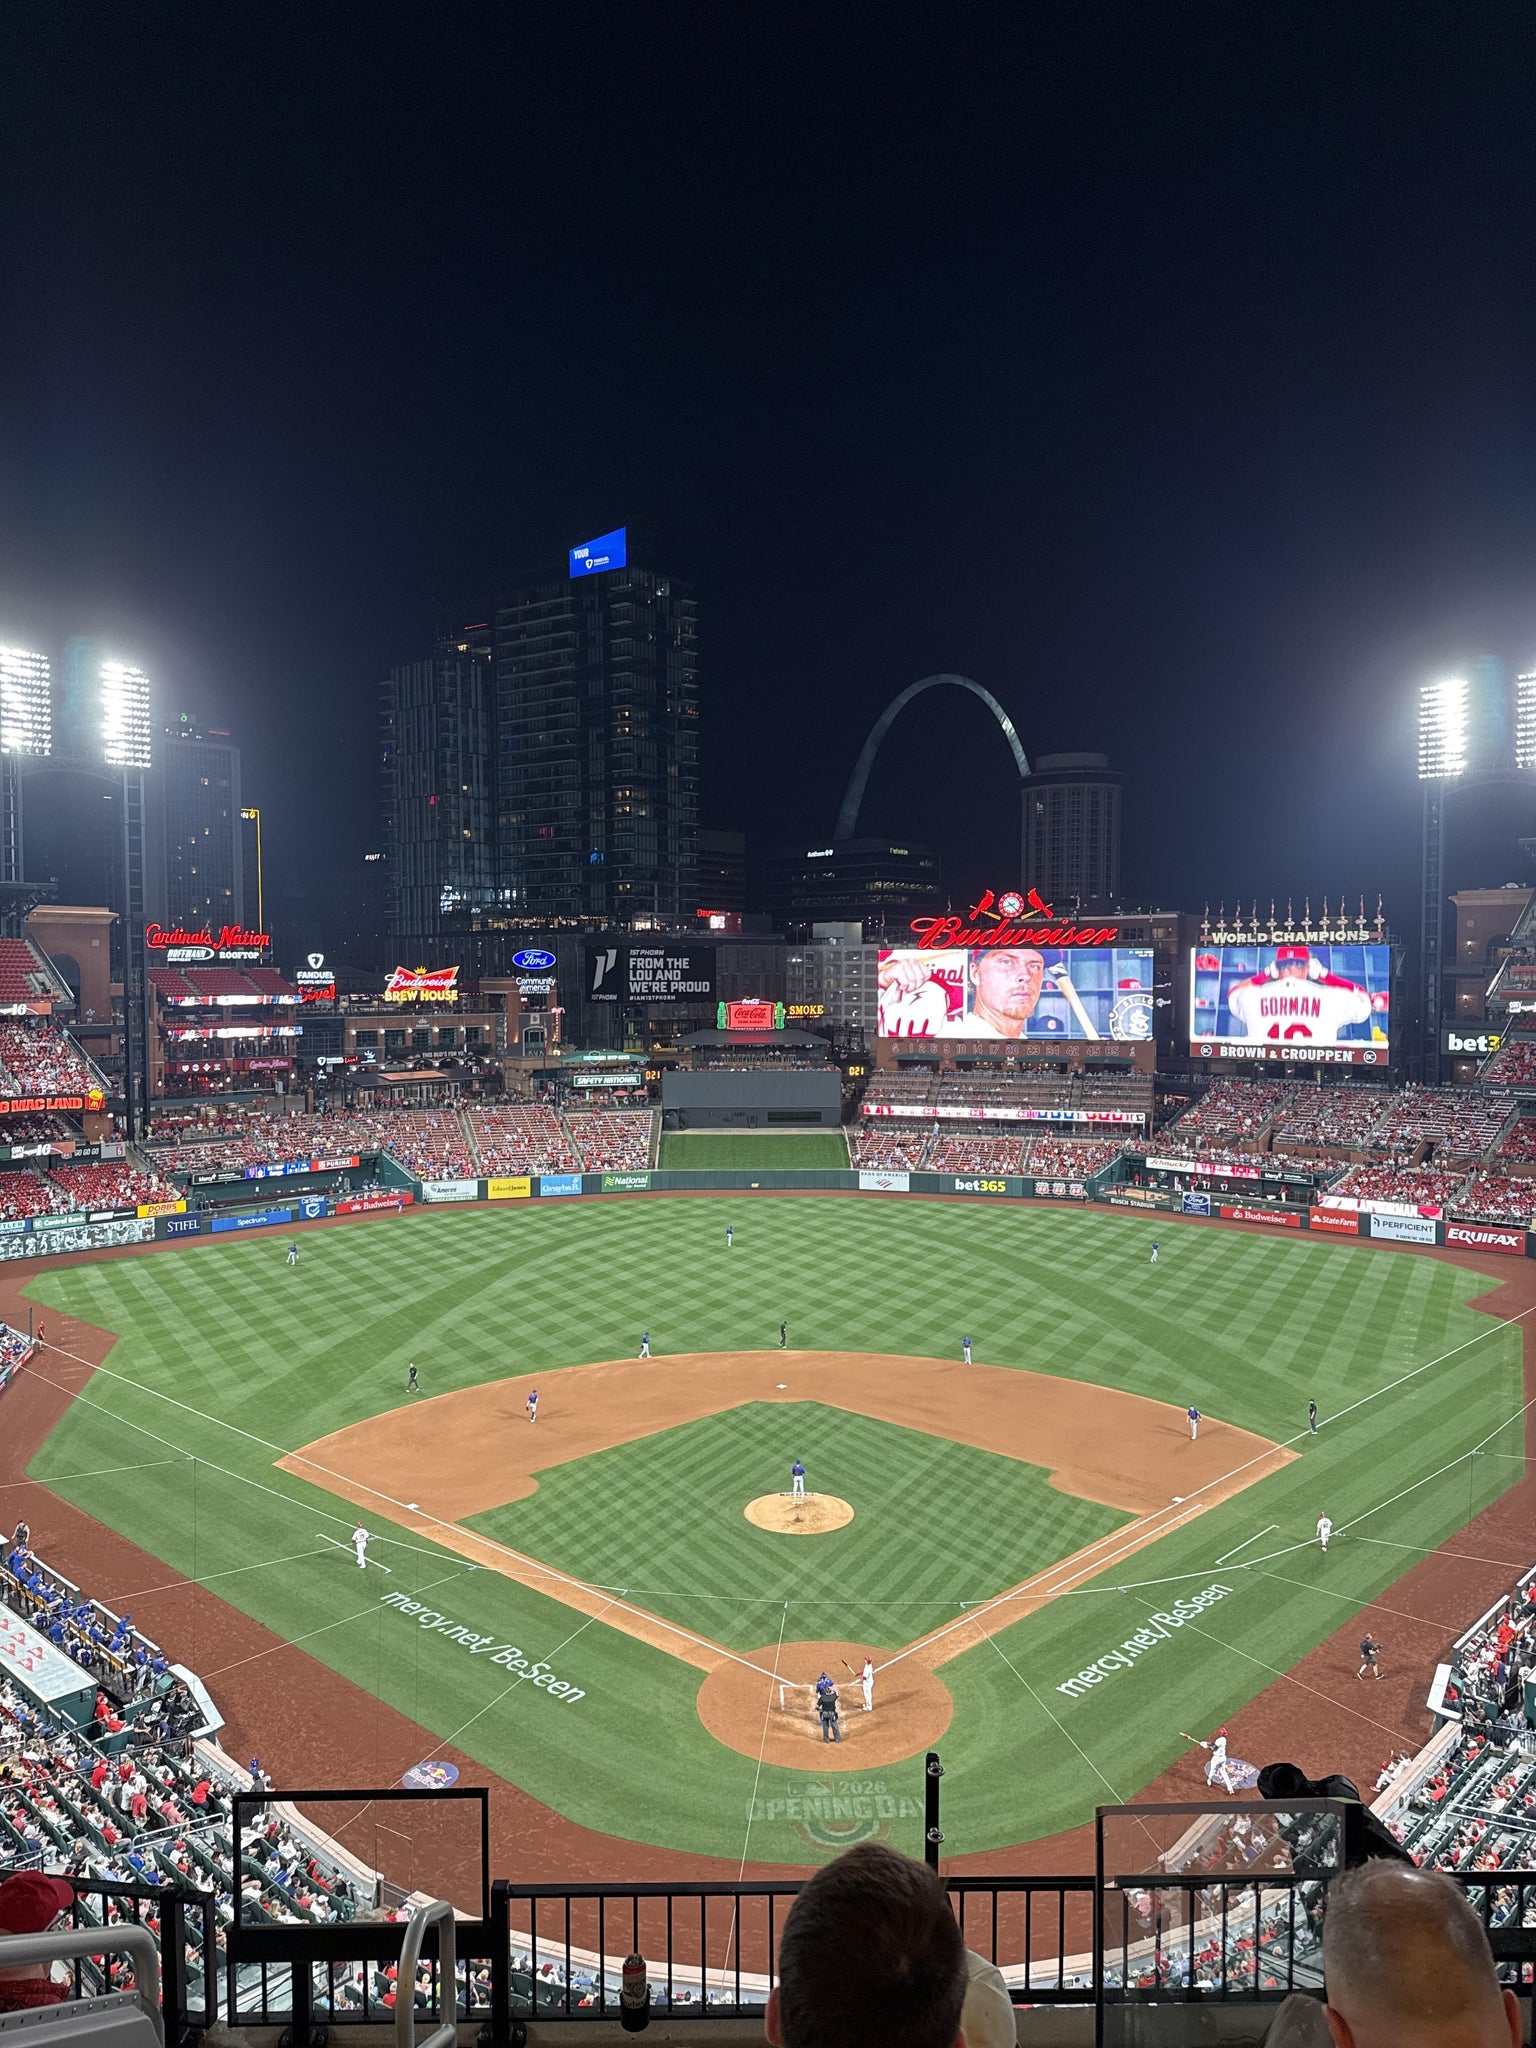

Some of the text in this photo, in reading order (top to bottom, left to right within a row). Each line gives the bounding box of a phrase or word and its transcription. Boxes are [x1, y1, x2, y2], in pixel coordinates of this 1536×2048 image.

[574, 548, 589, 559] YOUR
[146, 923, 270, 949] Cardinals Nation
[910, 917, 1118, 950] Budweiser
[1212, 930, 1370, 944] WORLD CHAMPIONS
[220, 951, 259, 959] ROOFTOP
[522, 952, 548, 966] Ford
[629, 958, 690, 969] FROM THE
[297, 971, 335, 979] FANDUEL
[629, 970, 681, 981] LOU AND
[383, 974, 458, 989] Budweiser
[516, 977, 556, 987] Community
[629, 981, 710, 993] WE'RE PROUD
[385, 990, 458, 1002] BREW HOUSE
[12, 1003, 27, 1015] 16
[734, 1007, 767, 1019] Coca-Cola
[789, 1005, 824, 1014] SMOKE
[1260, 997, 1321, 1018] GORMAN
[918, 1043, 926, 1053] 2
[943, 1043, 951, 1054] 9
[988, 1044, 1000, 1054] 17
[1026, 1045, 1040, 1055] 23
[1045, 1045, 1060, 1055] 24
[1065, 1046, 1080, 1056] 42
[1086, 1046, 1100, 1056] 45
[1220, 1046, 1266, 1058] BROWN
[1269, 1050, 1278, 1059] &
[1281, 1049, 1353, 1062] CROUPPEN
[603, 1076, 638, 1084] NATIONAL
[11, 1098, 45, 1112] MAC
[46, 1097, 83, 1110] LAND
[116, 1147, 122, 1155] 6
[326, 1159, 351, 1167] PURINA
[1150, 1159, 1191, 1168] Schnucks
[615, 1176, 649, 1185] National
[955, 1178, 1006, 1192] bet365
[148, 1203, 177, 1212] DOBBS
[363, 1200, 399, 1210] Budweise
[1110, 1198, 1155, 1209] BUSCH STADIUM
[44, 1217, 67, 1226] Central
[68, 1214, 86, 1223] Bank
[237, 1216, 264, 1227] Spectrum
[1245, 1210, 1288, 1224] Budweiser
[0, 1220, 23, 1229] TLER
[167, 1219, 200, 1233] STIFEL
[1382, 1220, 1434, 1233] PERFICIENT
[1447, 1228, 1519, 1247] EQUIFAX
[1056, 1583, 1234, 1698] mercy.net/BeSeen
[380, 1591, 586, 1704] mercy.net/BeSeen
[839, 1781, 887, 1794] 2026
[745, 1796, 873, 1821] OPENING
